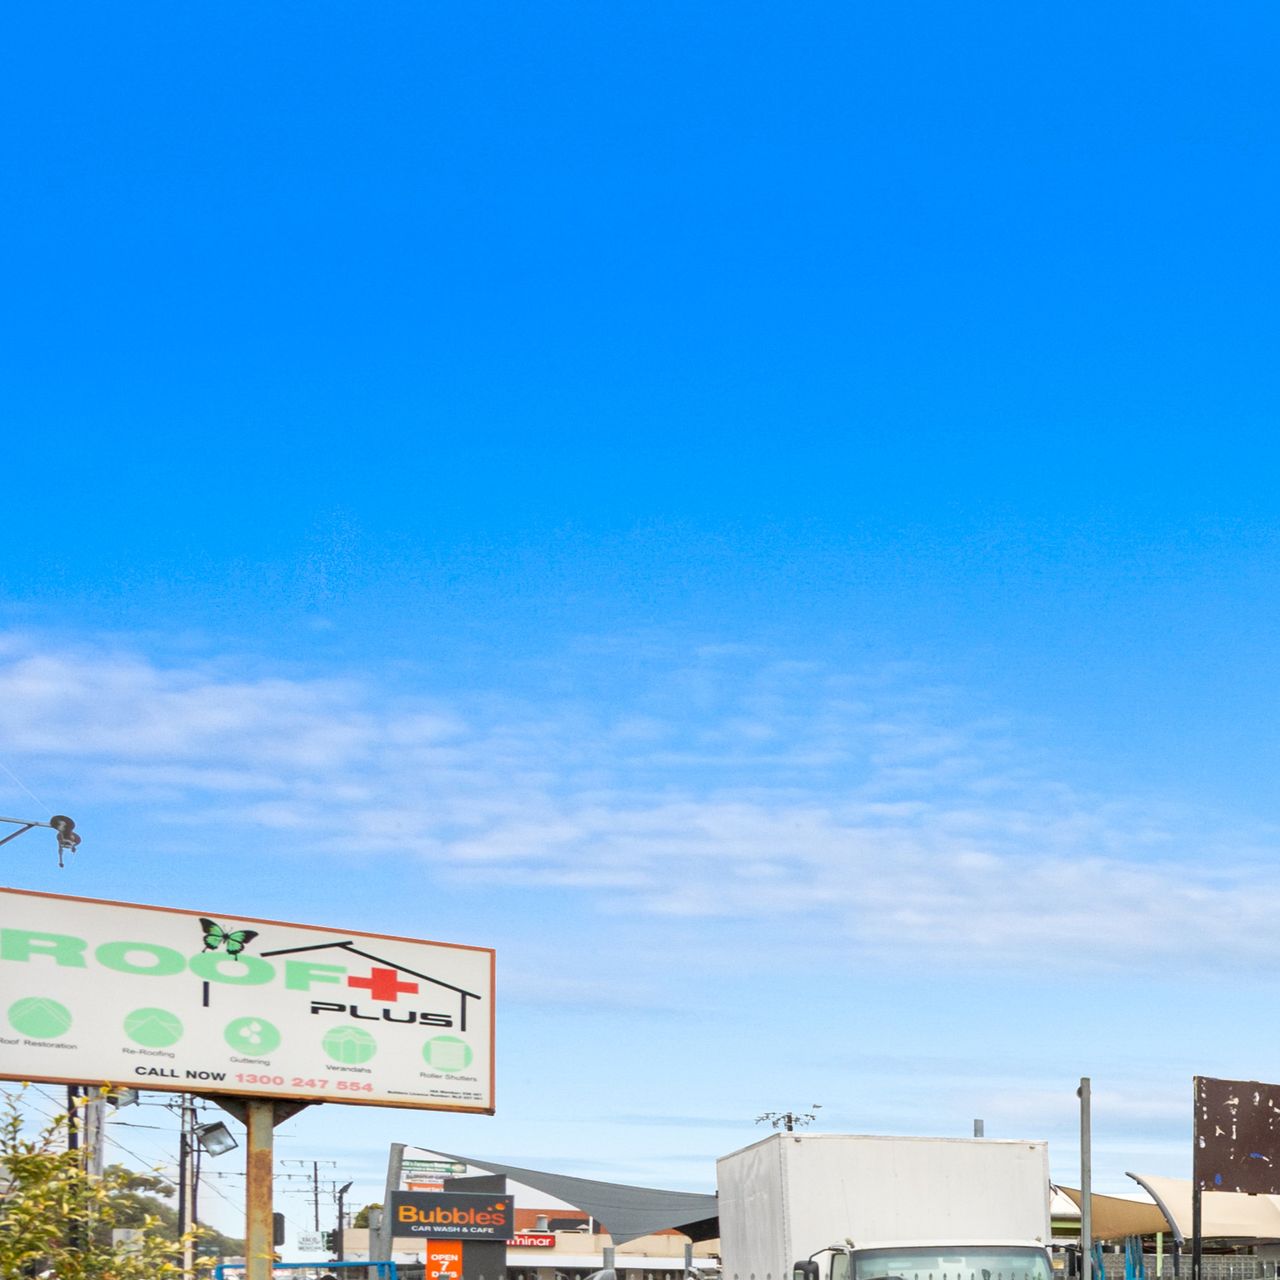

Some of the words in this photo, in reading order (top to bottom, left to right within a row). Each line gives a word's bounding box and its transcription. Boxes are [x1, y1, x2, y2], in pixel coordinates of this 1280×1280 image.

[0, 928, 348, 992] ROOF
[310, 1001, 453, 1028] PLUS
[24, 1039, 78, 1050] Restoration
[122, 1047, 175, 1059] Re-Roofing
[230, 1056, 271, 1066] Guttering
[135, 1066, 180, 1079] CALL
[186, 1069, 226, 1082] NOW
[326, 1064, 372, 1074] Verandahs
[235, 1073, 285, 1086] 1300
[291, 1077, 329, 1090] 247
[336, 1080, 373, 1093] 554
[419, 1071, 443, 1081] Roller
[444, 1074, 478, 1083] Shutters
[398, 1204, 506, 1226] Bubbles
[440, 1261, 449, 1272] 7
